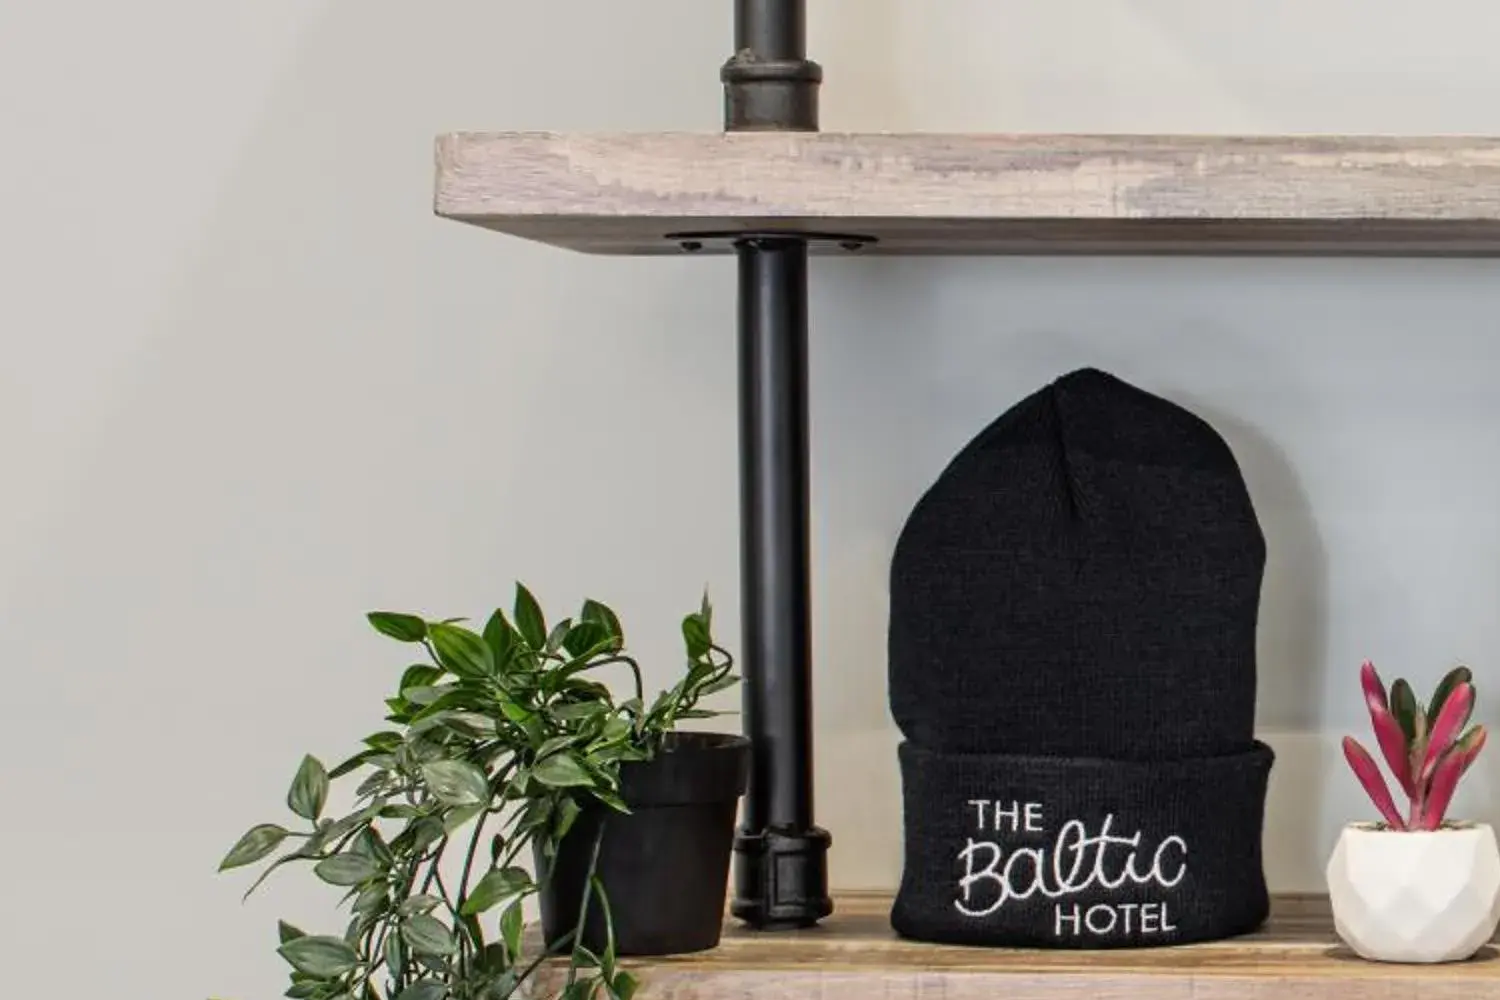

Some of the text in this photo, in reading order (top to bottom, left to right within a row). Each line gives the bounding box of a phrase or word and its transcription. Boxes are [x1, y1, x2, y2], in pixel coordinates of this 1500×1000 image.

[967, 798, 1044, 832] THE
[953, 813, 1188, 917] Baltic
[1054, 901, 1177, 936] HOTEL
